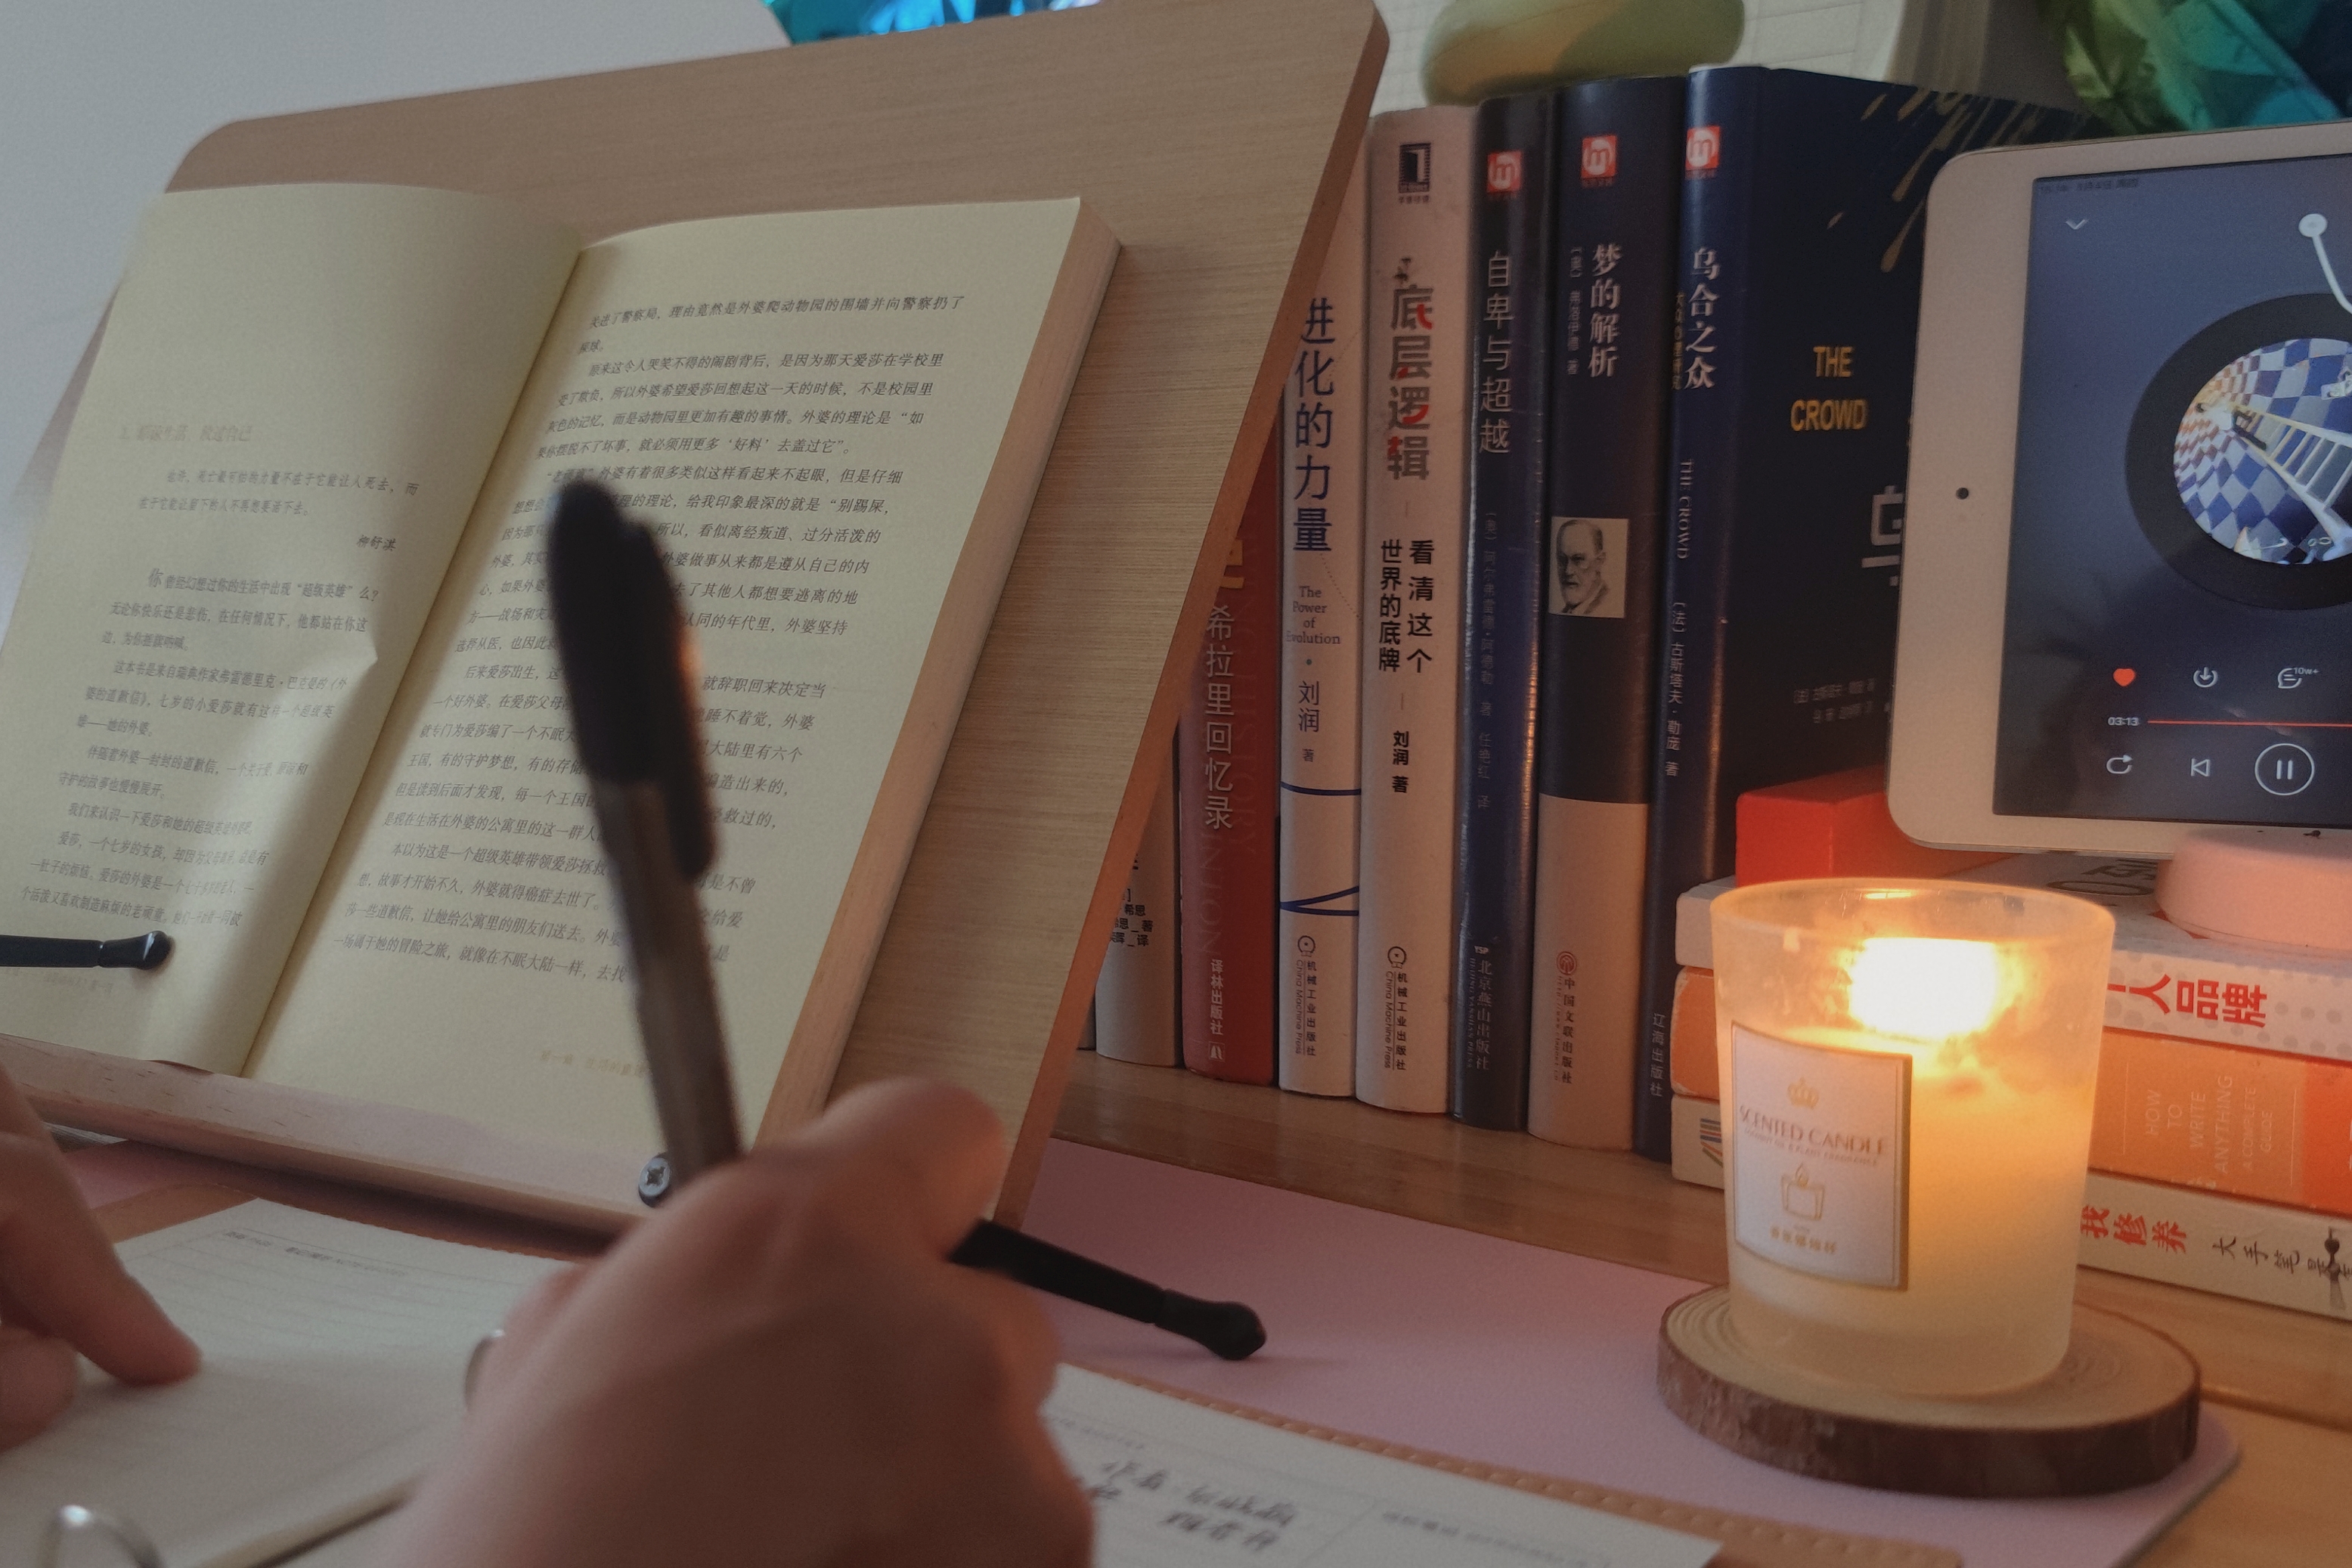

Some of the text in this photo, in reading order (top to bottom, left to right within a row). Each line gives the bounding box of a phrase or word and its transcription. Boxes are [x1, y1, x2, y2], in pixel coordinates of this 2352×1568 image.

[1588, 242, 1622, 377] 梦的解析
[1684, 246, 1721, 389] 乌合之众
[1387, 284, 1434, 481] 底层逻辑
[1479, 250, 1514, 454] 自卑与超越
[1813, 346, 1853, 378] THE
[1294, 297, 1336, 552] 进化的力量
[1790, 398, 1869, 431] CROWD
[1677, 458, 1694, 559] THE CROWD
[1293, 601, 1328, 614] Power
[1299, 585, 1322, 598] The
[1303, 618, 1316, 628] of
[1379, 539, 1402, 673] 世界的底牌
[1406, 539, 1435, 674] 看清这个
[1286, 631, 1340, 644] Evolution
[2293, 666, 2319, 675] 10w+
[1205, 605, 1235, 830] 希拉里回忆录
[1298, 680, 1320, 733] 刘润
[2107, 717, 2140, 727] 03:13
[1392, 730, 1409, 793] 刘润 著
[1210, 959, 1223, 1035] 译林出版社
[1476, 959, 1493, 1070] 北京燕山出版社
[2107, 974, 2267, 1028] 人品牌
[1561, 978, 1575, 1084] 中国文联出版社
[2145, 1089, 2161, 1135] HOW
[2167, 1103, 2183, 1129] TO
[2189, 1092, 2206, 1149] WRITE
[2214, 1074, 2233, 1174] ANYTHING
